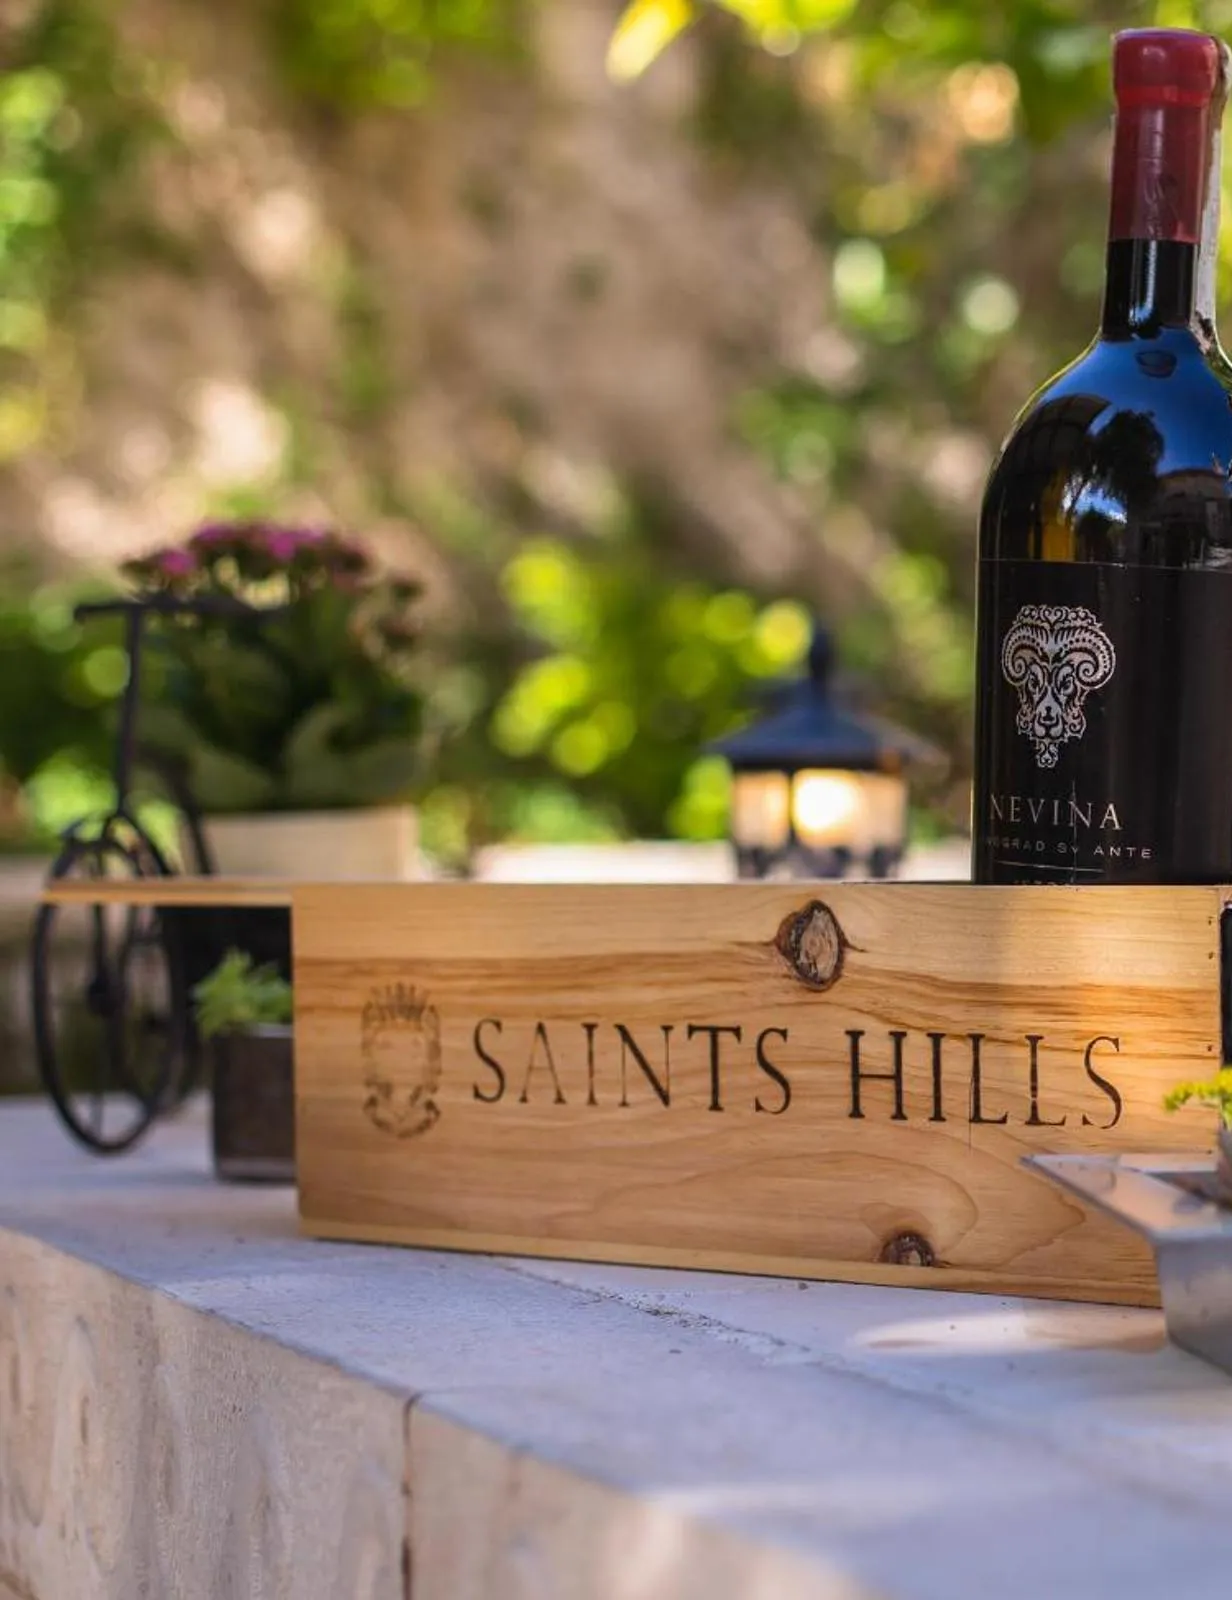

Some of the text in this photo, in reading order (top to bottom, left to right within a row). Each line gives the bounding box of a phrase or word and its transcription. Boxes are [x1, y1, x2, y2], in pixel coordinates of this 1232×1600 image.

[990, 793, 1124, 831] NEVINA
[1093, 844, 1153, 860] ANTE
[471, 1017, 1125, 1131] SAINTS HILLS
